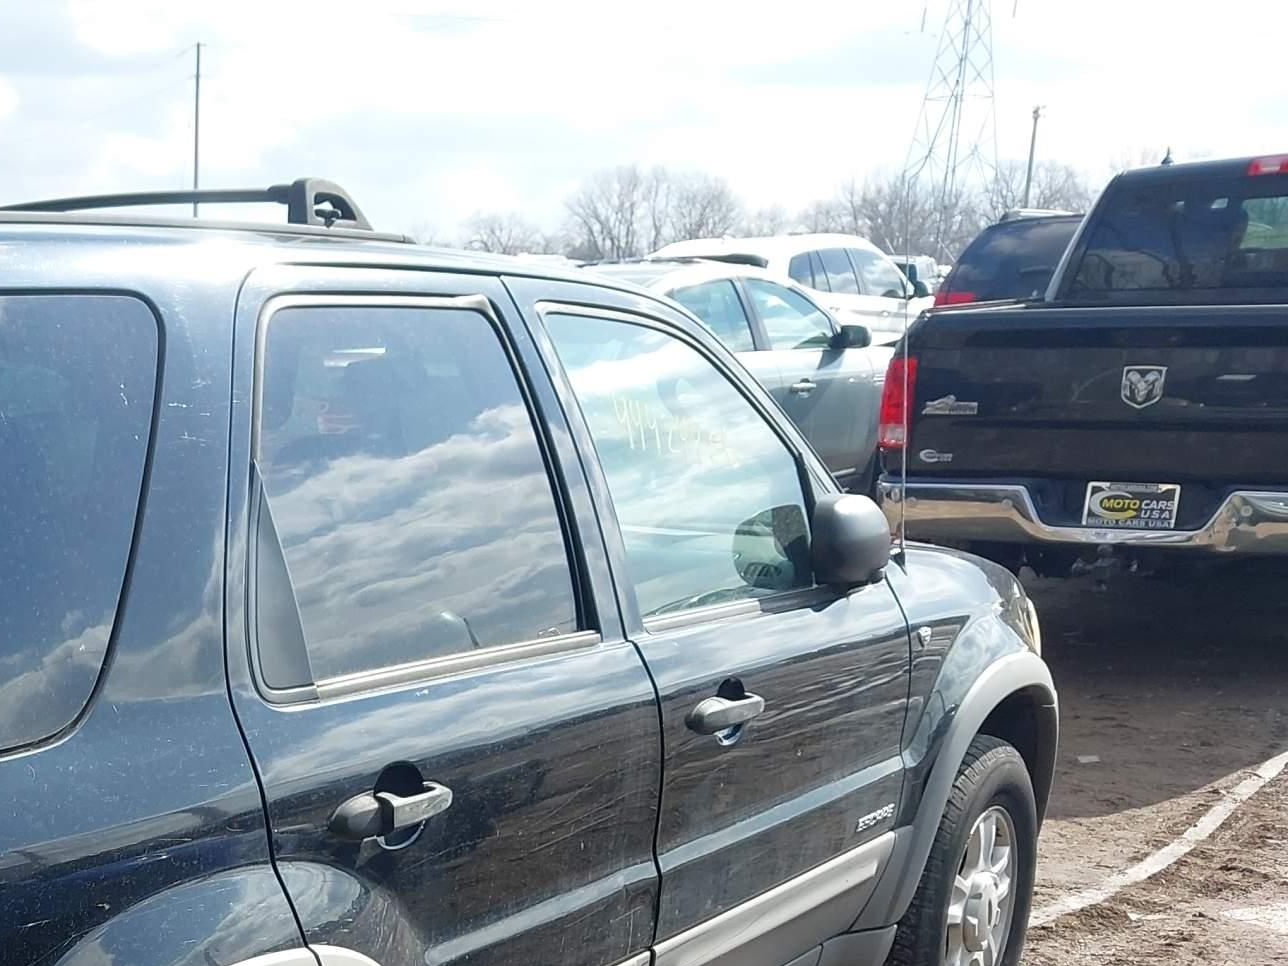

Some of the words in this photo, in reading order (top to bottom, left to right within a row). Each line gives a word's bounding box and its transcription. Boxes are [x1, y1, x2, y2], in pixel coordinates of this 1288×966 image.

[1102, 499, 1140, 509] MOTO
[1141, 500, 1175, 510] CARS
[1140, 510, 1170, 519] USA
